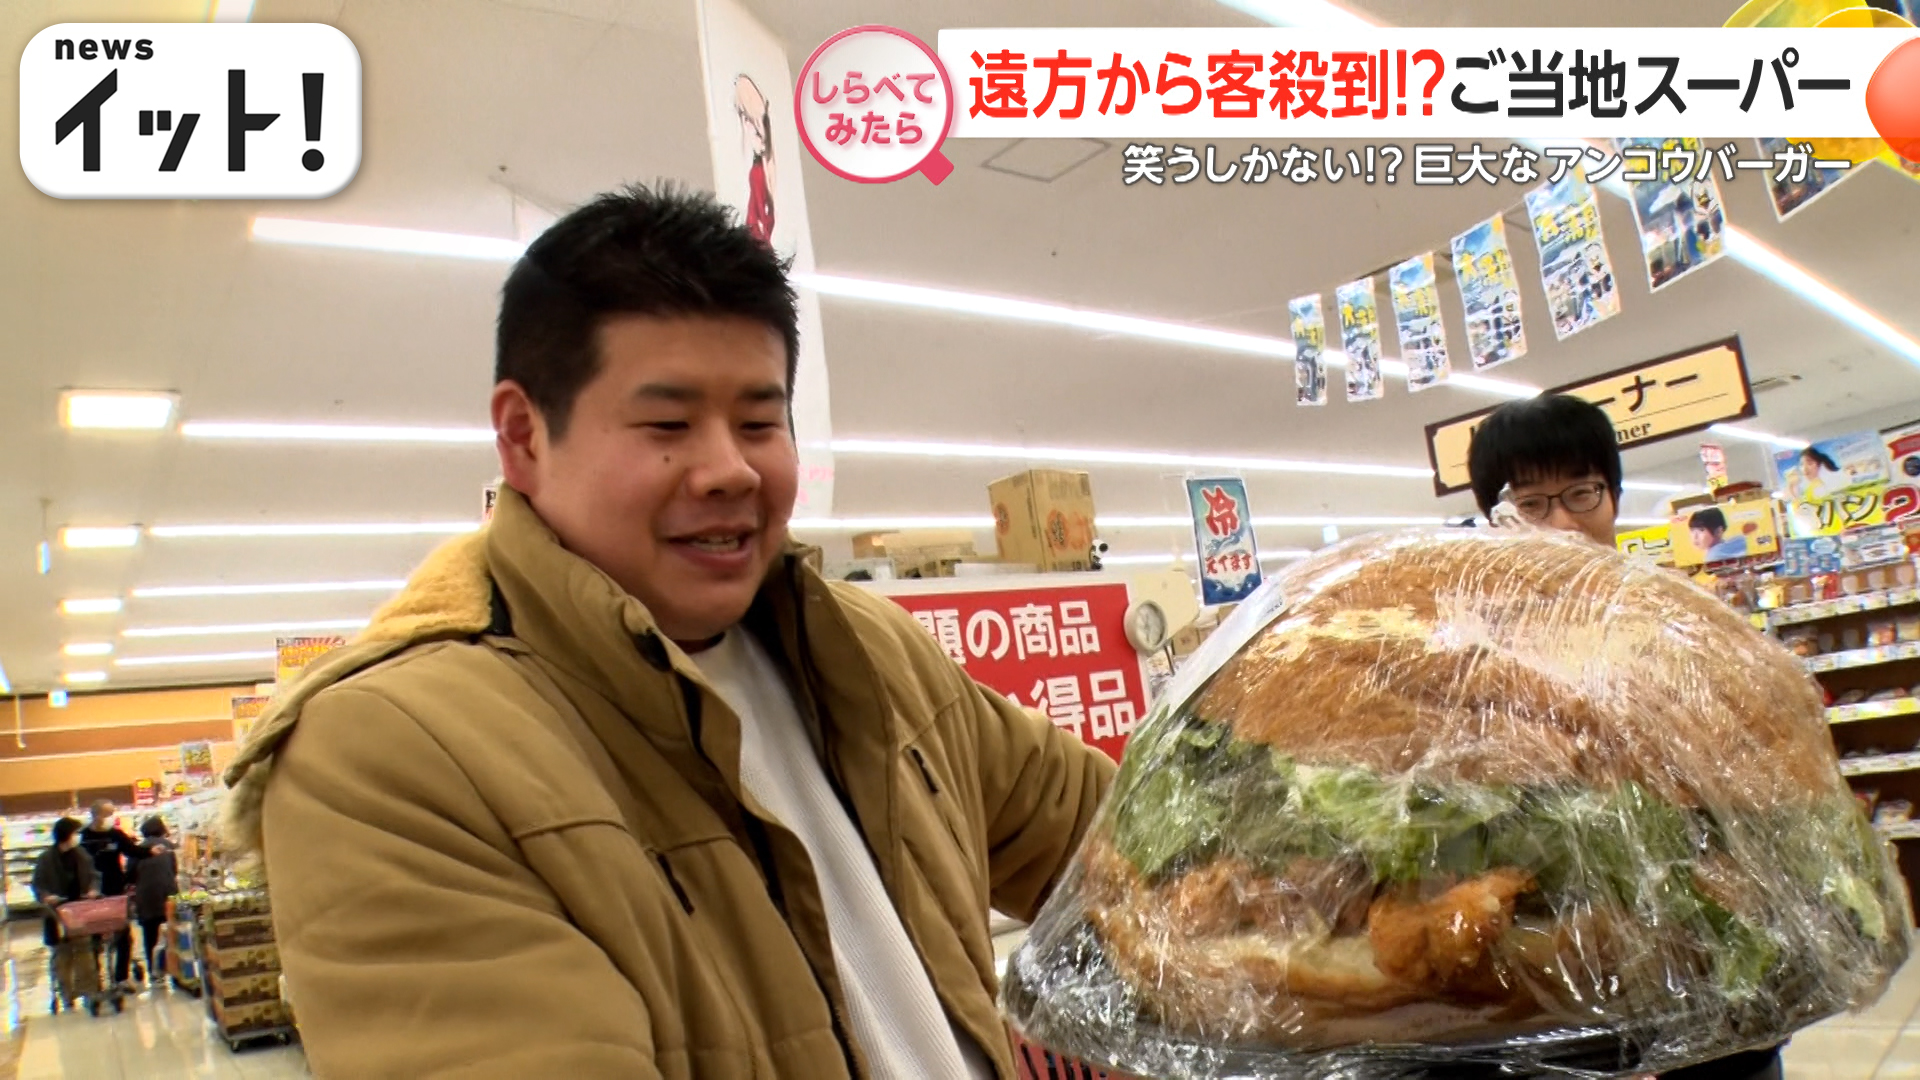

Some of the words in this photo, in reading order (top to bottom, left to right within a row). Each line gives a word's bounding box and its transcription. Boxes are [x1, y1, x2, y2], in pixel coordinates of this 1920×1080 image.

[1616, 422, 1652, 443] ner
[1201, 485, 1239, 536] 冷
[1008, 668, 1138, 742] 得品
